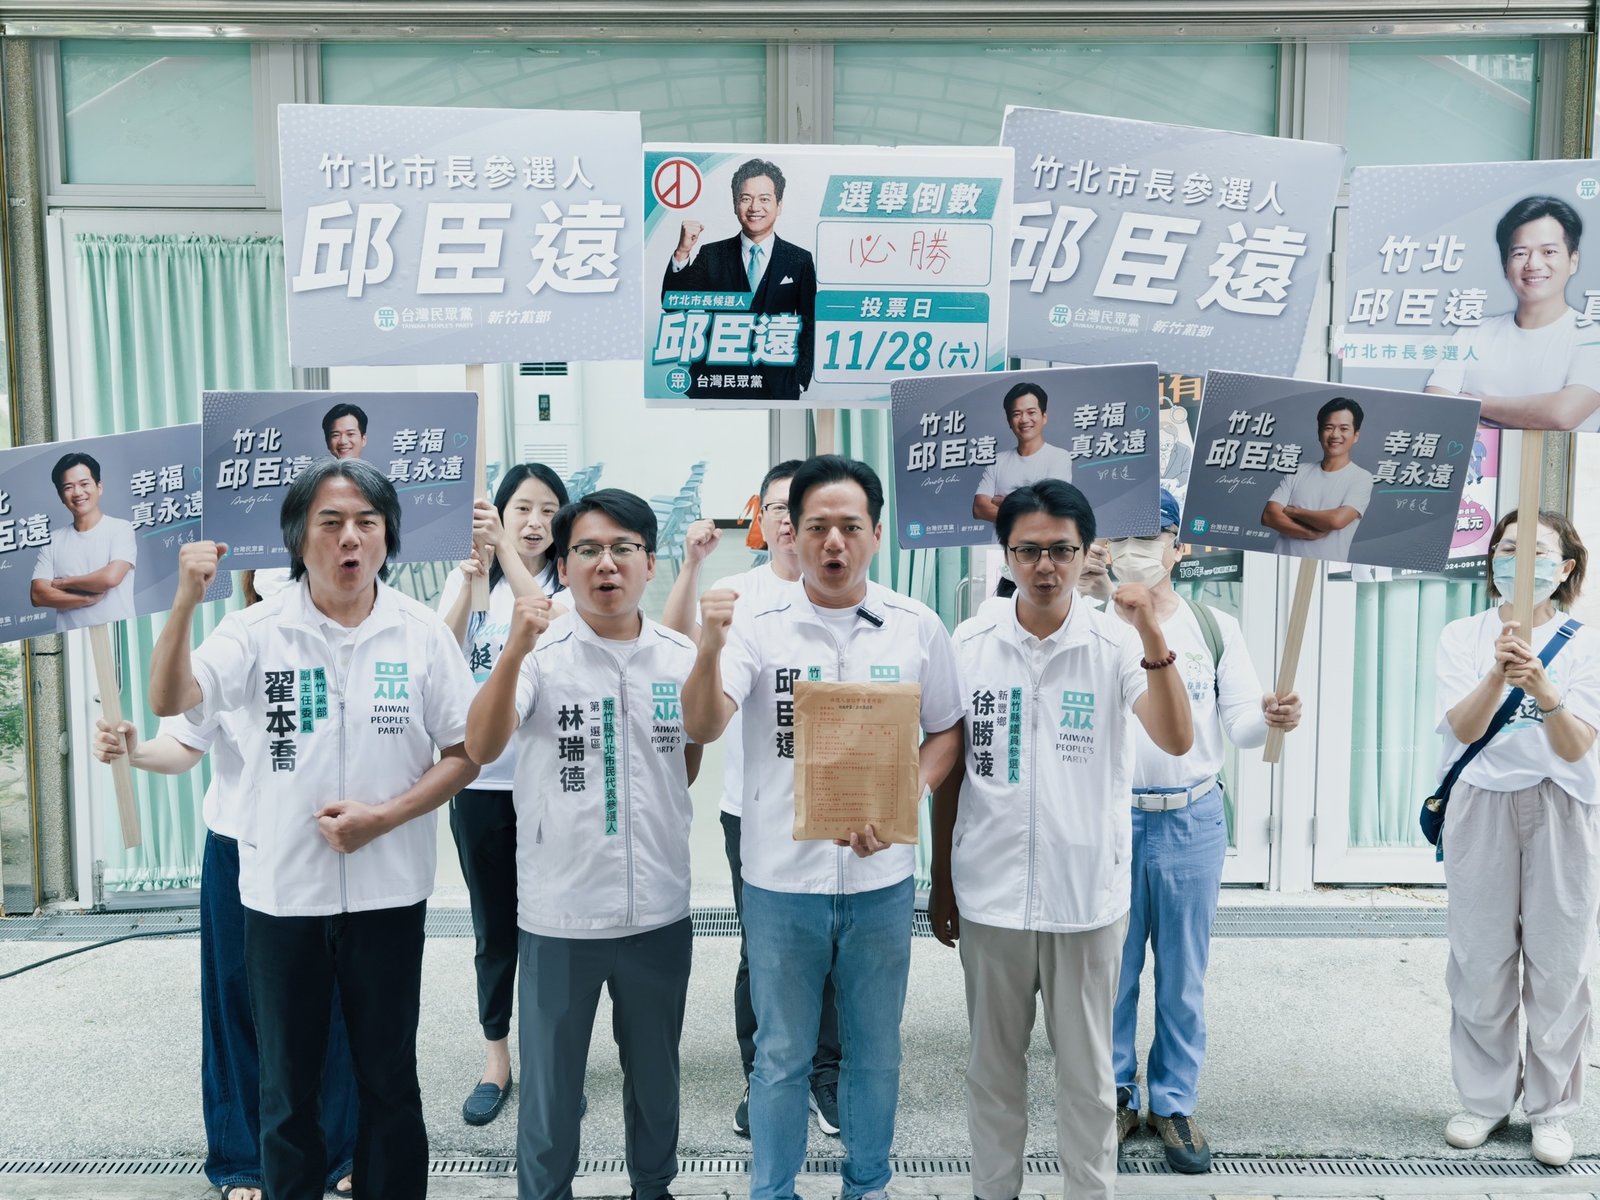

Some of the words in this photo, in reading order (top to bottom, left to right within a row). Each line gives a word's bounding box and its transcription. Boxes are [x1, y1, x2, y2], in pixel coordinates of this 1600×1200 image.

[319, 153, 594, 189] 竹北市長參選人
[1030, 153, 1285, 216] 竹北市長參選人
[837, 181, 983, 214] 選舉倒數
[293, 199, 625, 297] 邱臣遠
[849, 227, 951, 275] 必勝
[1010, 200, 1307, 316] 邱臣遠
[1379, 235, 1465, 274] 竹北
[402, 307, 473, 323] 台灣民眾黨
[667, 293, 746, 308] 竹北市長候選人
[860, 297, 932, 319] 投票日
[1073, 307, 1141, 327] 台灣民眾黨
[1349, 287, 1488, 326] 邱臣遠
[653, 311, 801, 365] 邱臣遠
[1343, 343, 1479, 361] 竹北市長參選人
[697, 374, 763, 389] 台灣民眾黨
[1159, 373, 1201, 407] 有
[919, 410, 966, 437] 竹北
[1073, 401, 1127, 431] 幸福
[1228, 410, 1276, 436] 竹北
[232, 427, 282, 453] 竹北
[393, 428, 445, 454] 幸福
[906, 435, 997, 472] 邱臣遠
[1070, 428, 1147, 461] 真永遠
[1205, 437, 1302, 475] 邱臣遠
[1384, 429, 1442, 459] 幸福
[130, 464, 184, 498] 幸福
[387, 457, 464, 483] 真永遠
[1372, 460, 1455, 490] 真永遠
[131, 490, 201, 530] 真永遠
[1455, 516, 1484, 531] 萬元
[314, 668, 328, 718] 新竹黨部
[373, 661, 410, 700] 眾
[300, 670, 313, 732] 副主任委員
[373, 705, 410, 713] TAIWAN
[651, 682, 680, 721] 眾
[996, 690, 1008, 728] 新豐鄉
[1060, 690, 1095, 731] 眾
[264, 670, 298, 773] 翟本喬
[370, 716, 410, 724] PEOPLE'S
[378, 727, 405, 735] PARTY
[589, 701, 601, 749] 第一選區
[652, 725, 680, 733] TAIWAN
[972, 690, 996, 778] 徐勝凌
[1008, 689, 1021, 781] 新竹縣議員參選人
[557, 704, 586, 793] 林瑞德
[1055, 743, 1095, 754] PEOPLE'S
[1059, 733, 1094, 744] TAIWAN
[602, 699, 617, 834] 新竹縣竹北市民代表參選人
[1062, 754, 1088, 764] PARTY
